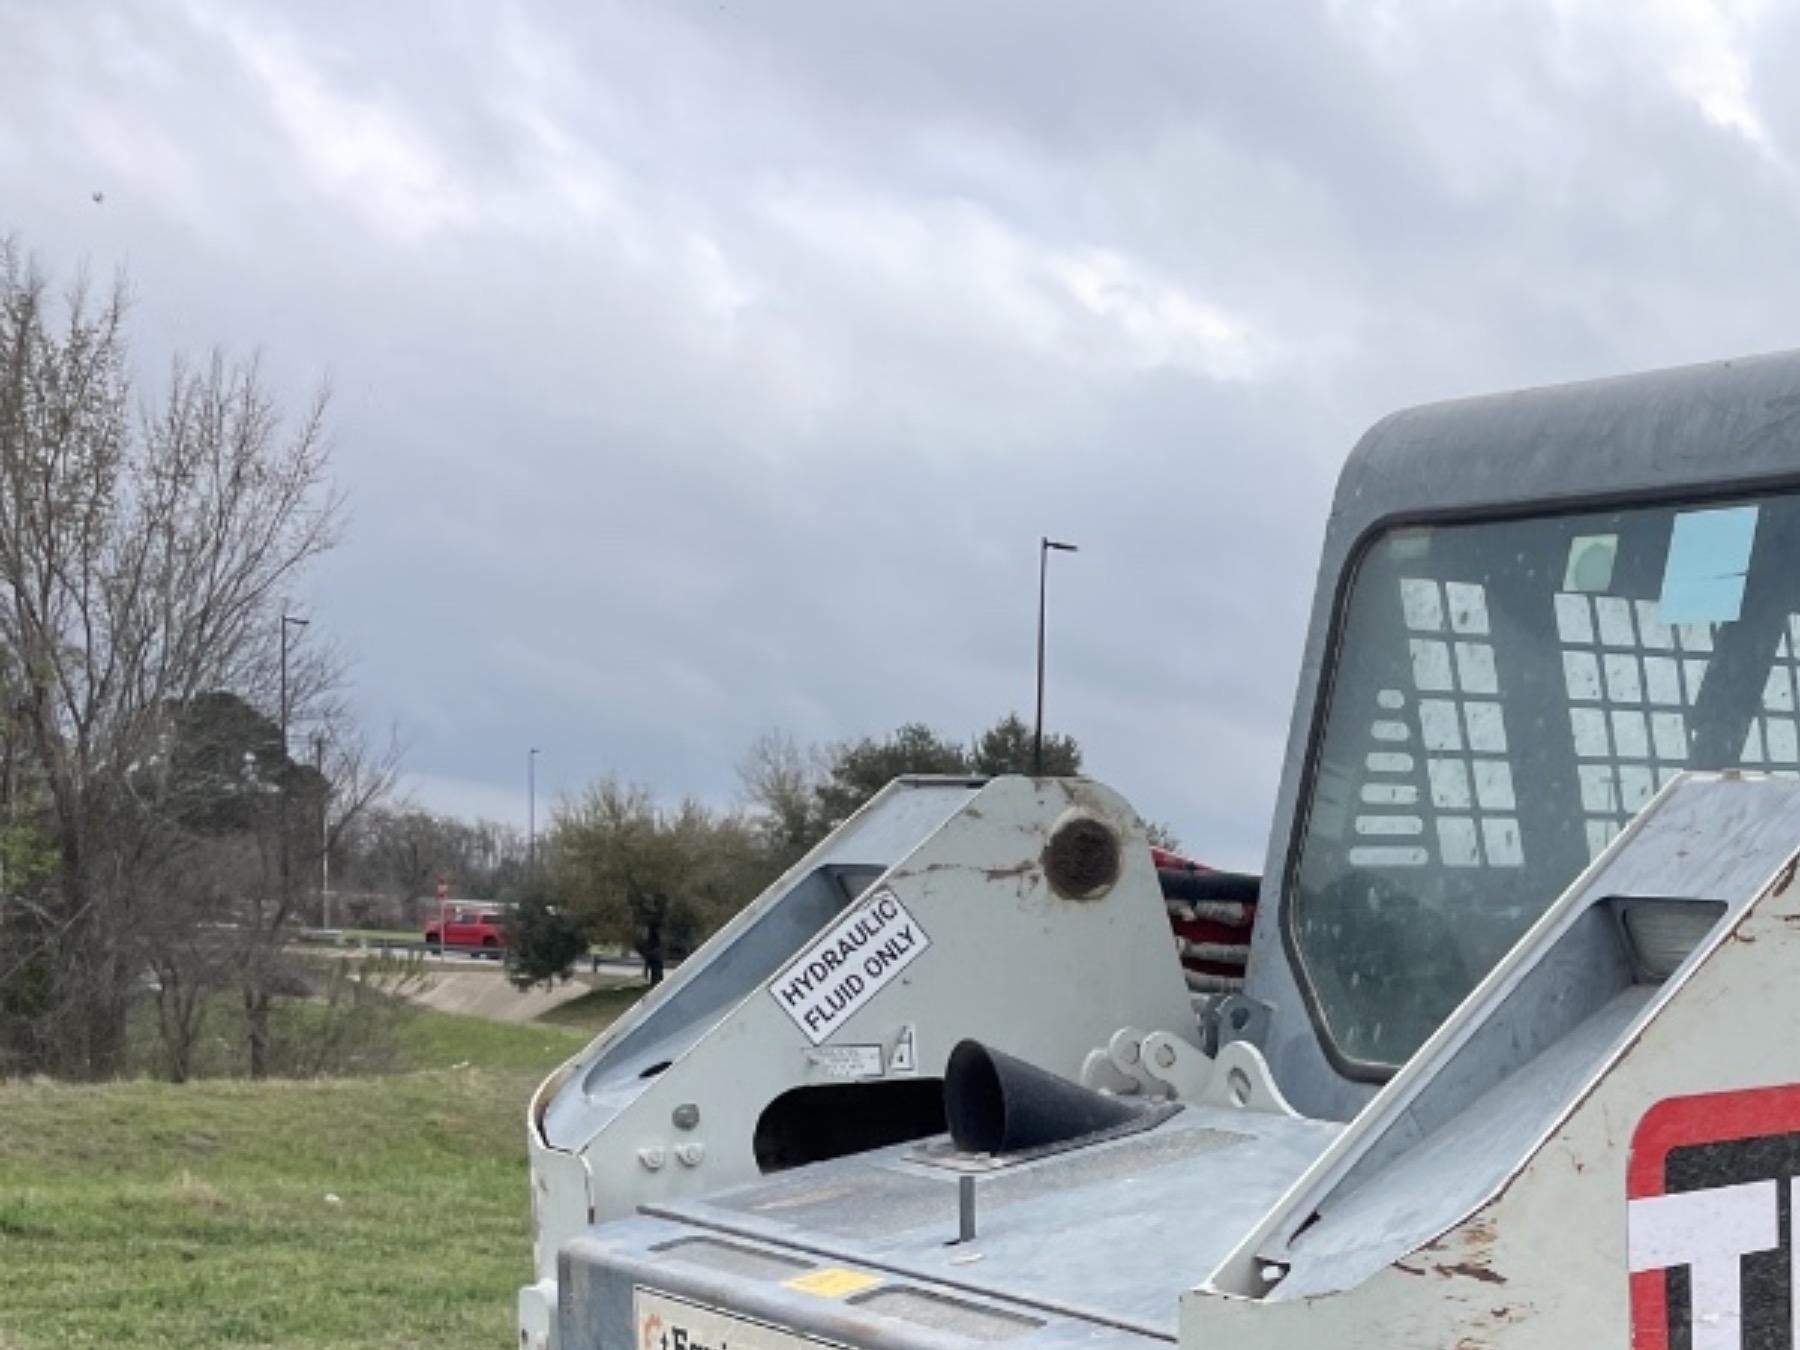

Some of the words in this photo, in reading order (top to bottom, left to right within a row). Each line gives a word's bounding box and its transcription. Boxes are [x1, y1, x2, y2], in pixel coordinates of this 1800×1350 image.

[781, 899, 898, 1006] HYDRAULIC
[803, 974, 865, 1031] FLUID
[864, 924, 916, 978] ONLY
